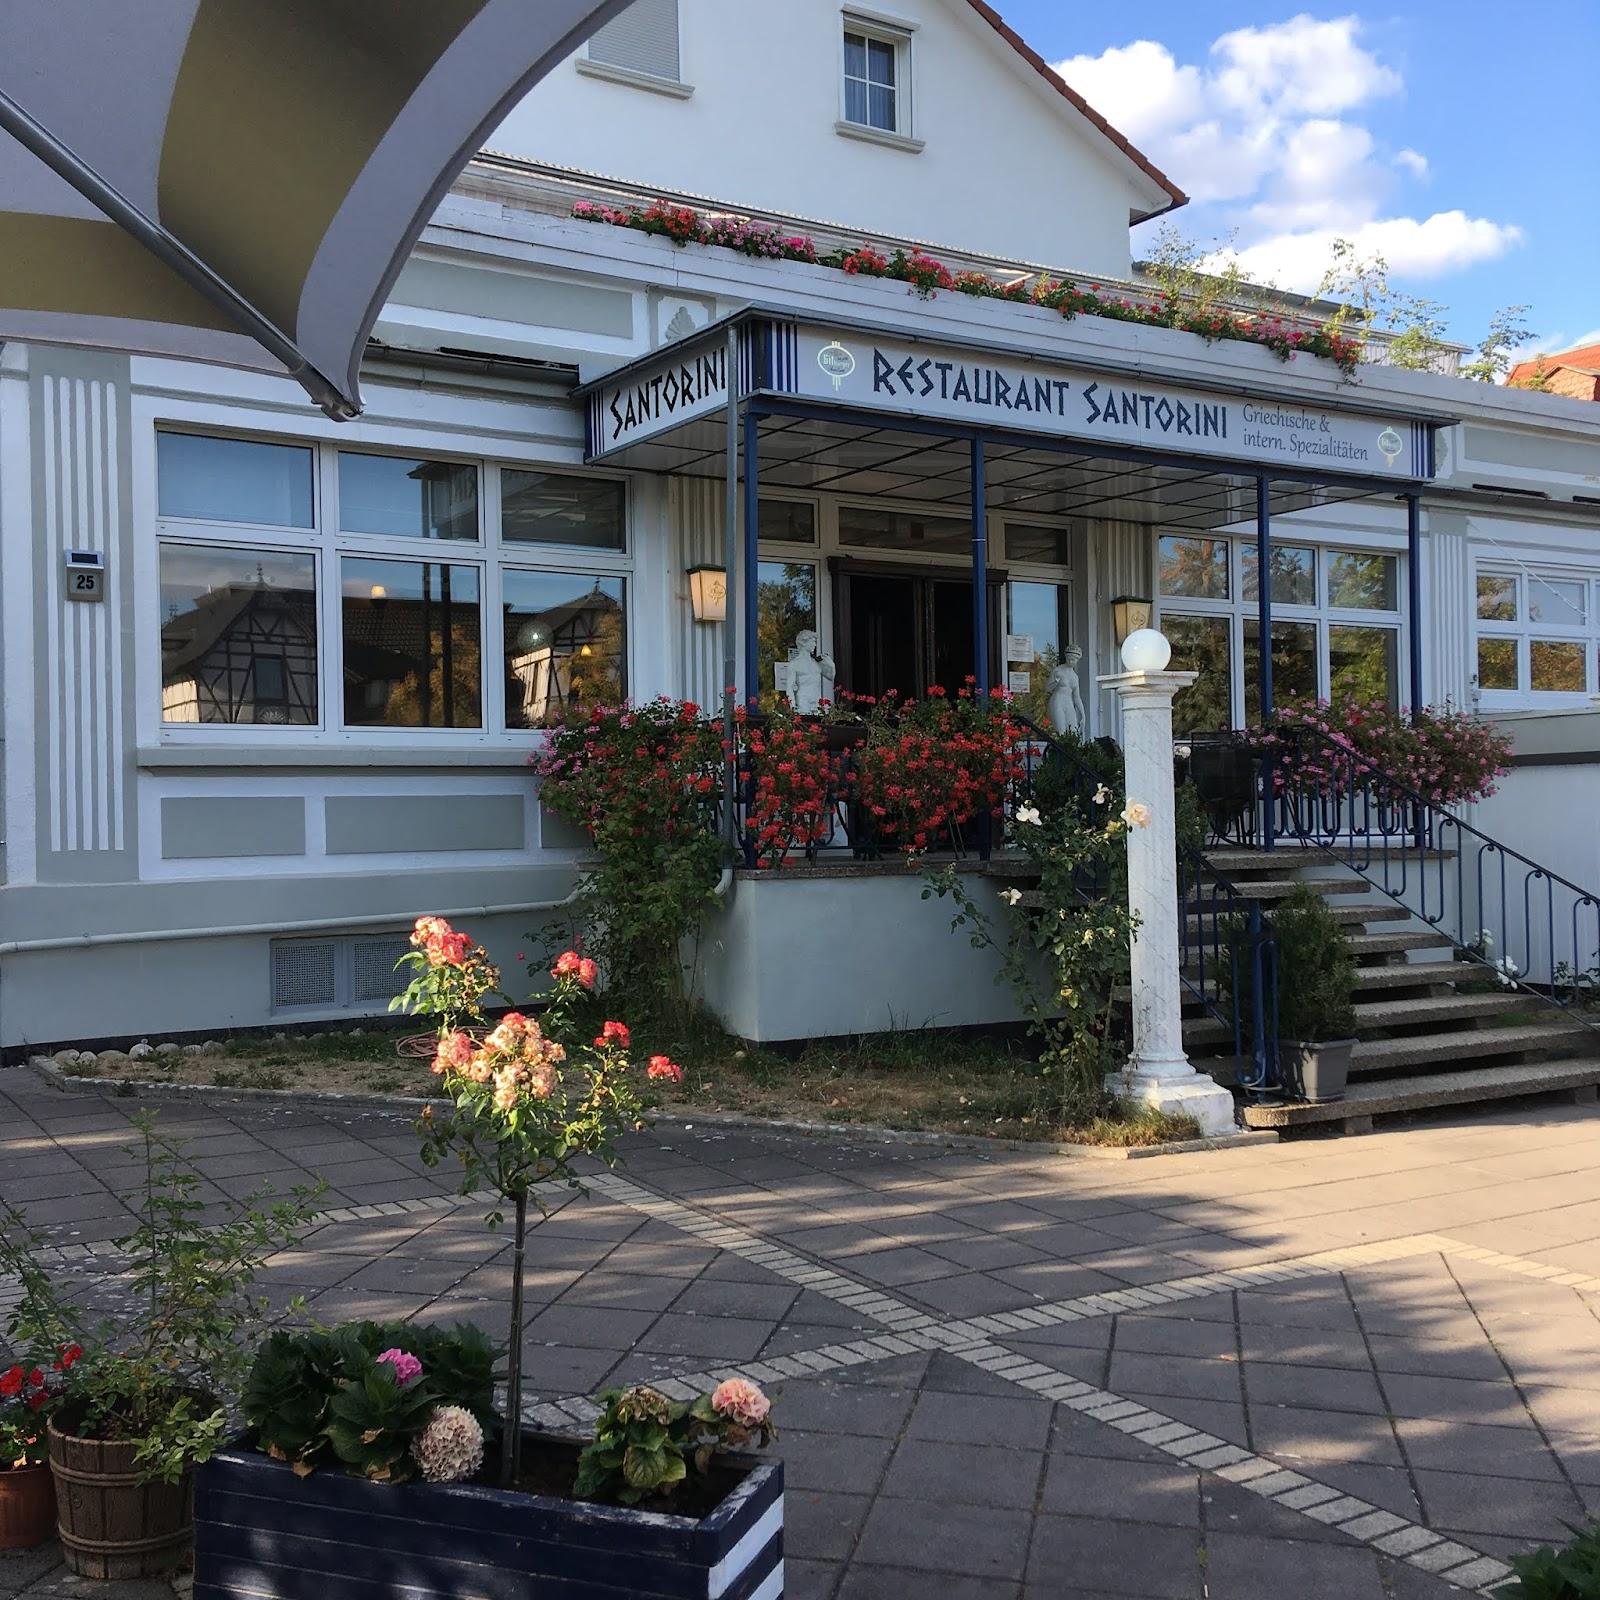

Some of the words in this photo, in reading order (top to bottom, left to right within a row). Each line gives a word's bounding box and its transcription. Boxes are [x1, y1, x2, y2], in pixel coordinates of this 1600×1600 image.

[610, 347, 726, 440] SANTORINI
[873, 347, 1070, 416] RESTAURANT
[1082, 382, 1228, 438] SANTORINI
[1243, 403, 1316, 431] Griechische
[1319, 414, 1331, 433] &
[1243, 428, 1287, 451] intern.
[1290, 433, 1369, 461] Spezialitäten
[77, 574, 95, 590] 25
